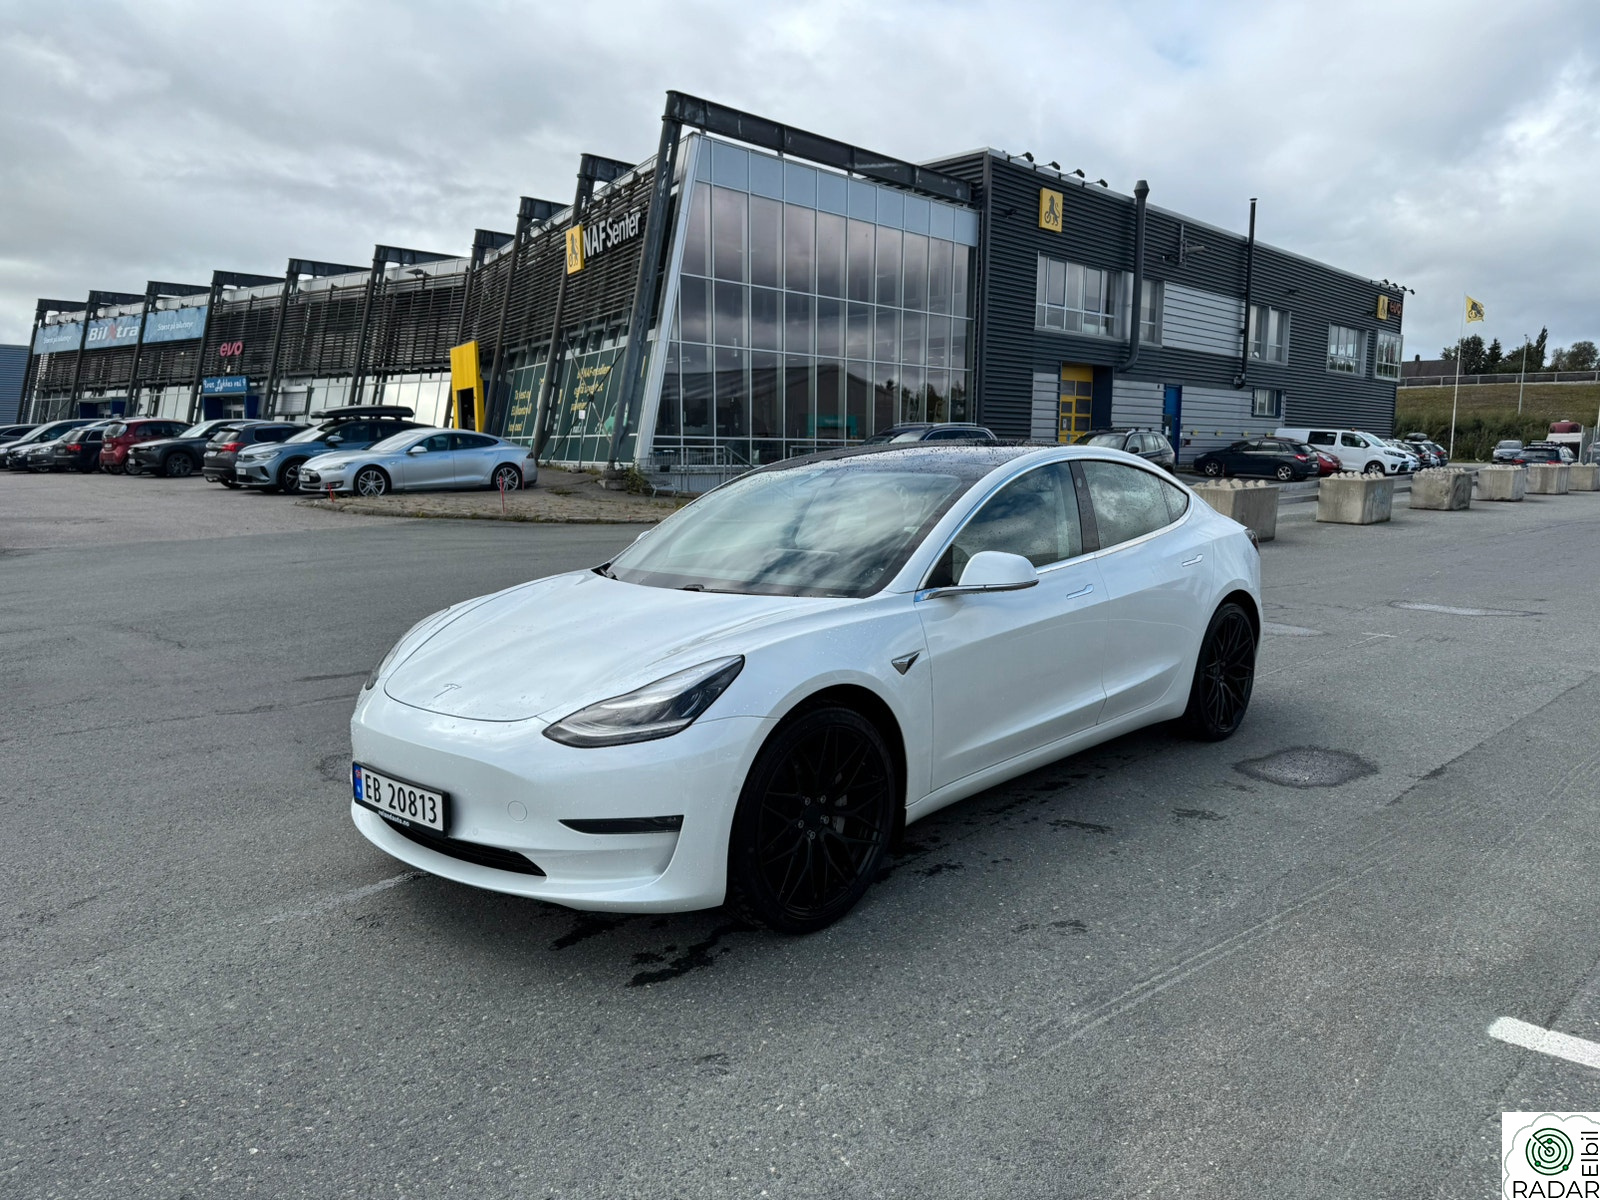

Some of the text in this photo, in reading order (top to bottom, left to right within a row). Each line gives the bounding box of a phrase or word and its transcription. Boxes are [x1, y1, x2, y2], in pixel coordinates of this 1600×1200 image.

[583, 212, 641, 259] NAF Senter
[88, 322, 139, 342] BilXtra
[220, 341, 243, 357] evo
[365, 774, 381, 803] EB
[387, 783, 437, 824] 20813
